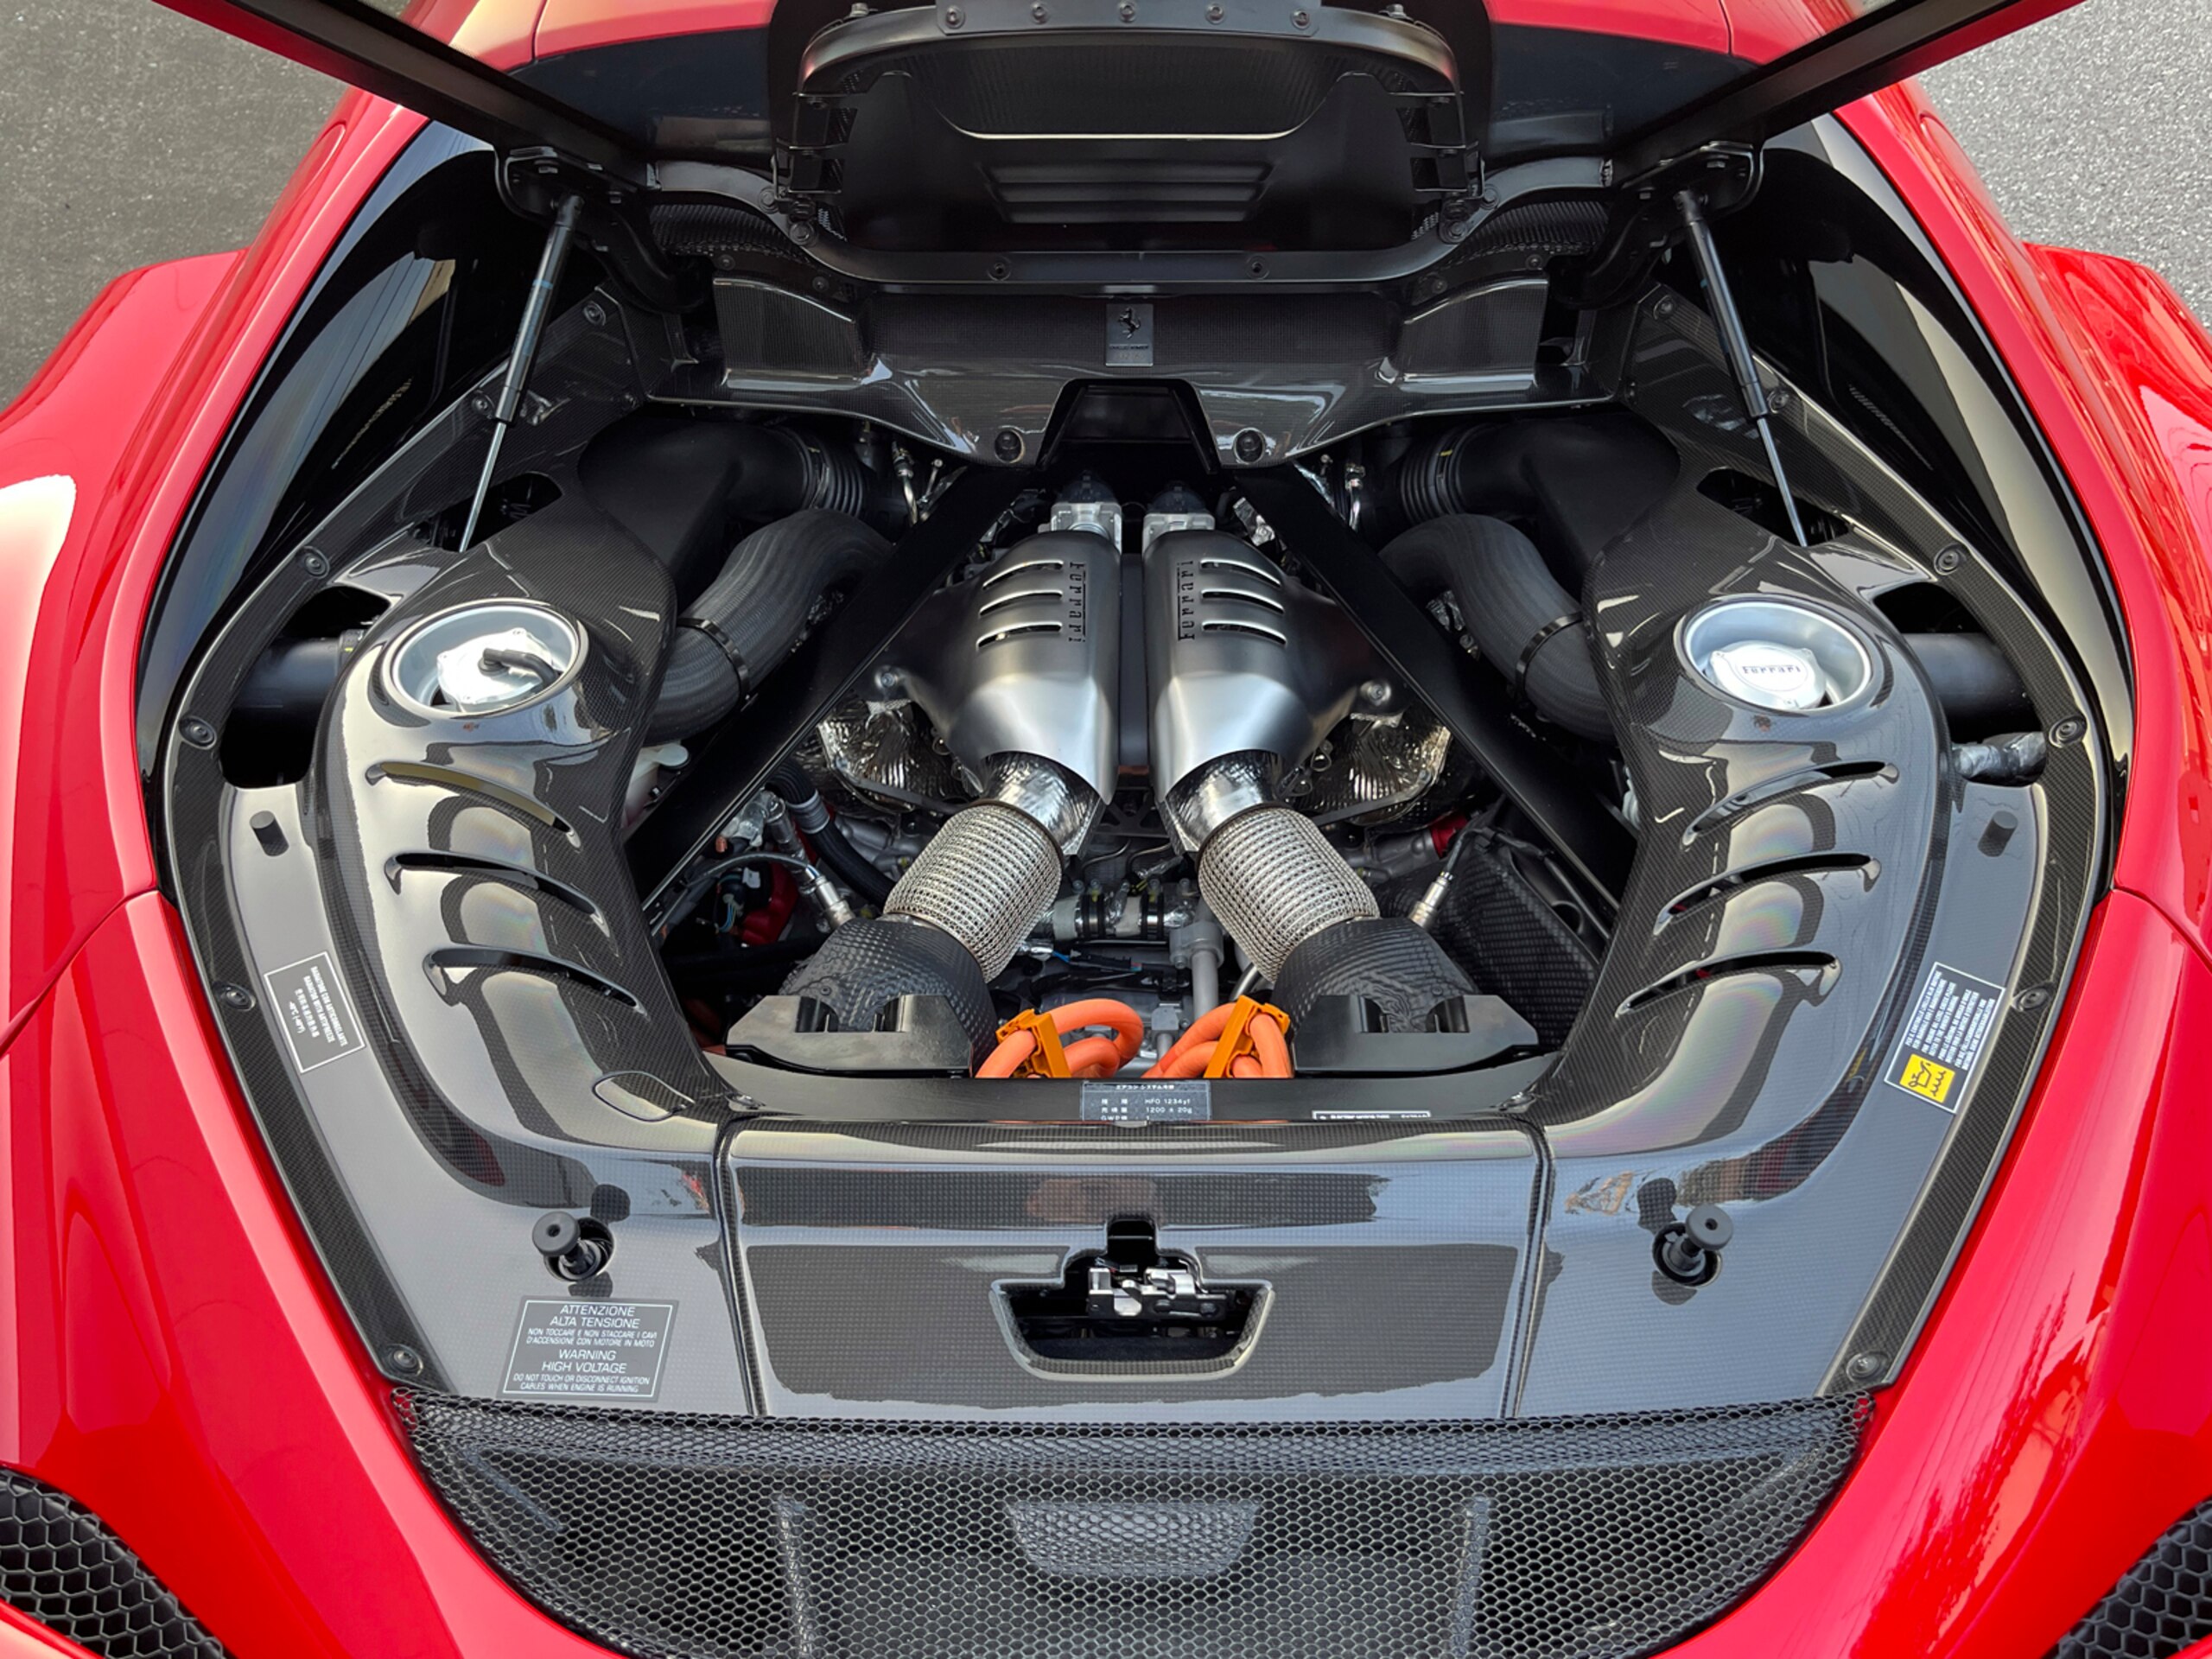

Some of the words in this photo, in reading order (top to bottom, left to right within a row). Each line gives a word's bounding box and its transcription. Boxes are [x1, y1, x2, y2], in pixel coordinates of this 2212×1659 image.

[1068, 562, 1086, 643] Ferrari
[1177, 561, 1195, 641] Ferrari
[1742, 664, 1801, 674] Ferrari
[560, 1305, 636, 1317] ATTENZIONE
[550, 1316, 577, 1326] ALTA
[581, 1317, 641, 1328] TENSIONE
[528, 1327, 543, 1336] NON
[545, 1328, 575, 1337] TOCCARE
[583, 1329, 600, 1338] NON
[601, 1330, 636, 1338] STACCARE
[526, 1336, 575, 1345] D'ACCENSIONE
[576, 1338, 592, 1346] CON
[633, 1339, 655, 1348] MOTO
[559, 1349, 617, 1361] WARNING
[542, 1361, 572, 1372] HIGH
[575, 1362, 627, 1374] VOLTAGE
[512, 1373, 524, 1382] DO
[525, 1373, 540, 1382] NOT
[540, 1374, 563, 1382] TOUCH
[575, 1375, 620, 1383] DISCONNECT
[620, 1376, 651, 1385] IGNITION
[520, 1382, 546, 1390] CABLES
[570, 1383, 596, 1392] ENGINE
[607, 1384, 639, 1394] RUNNING
